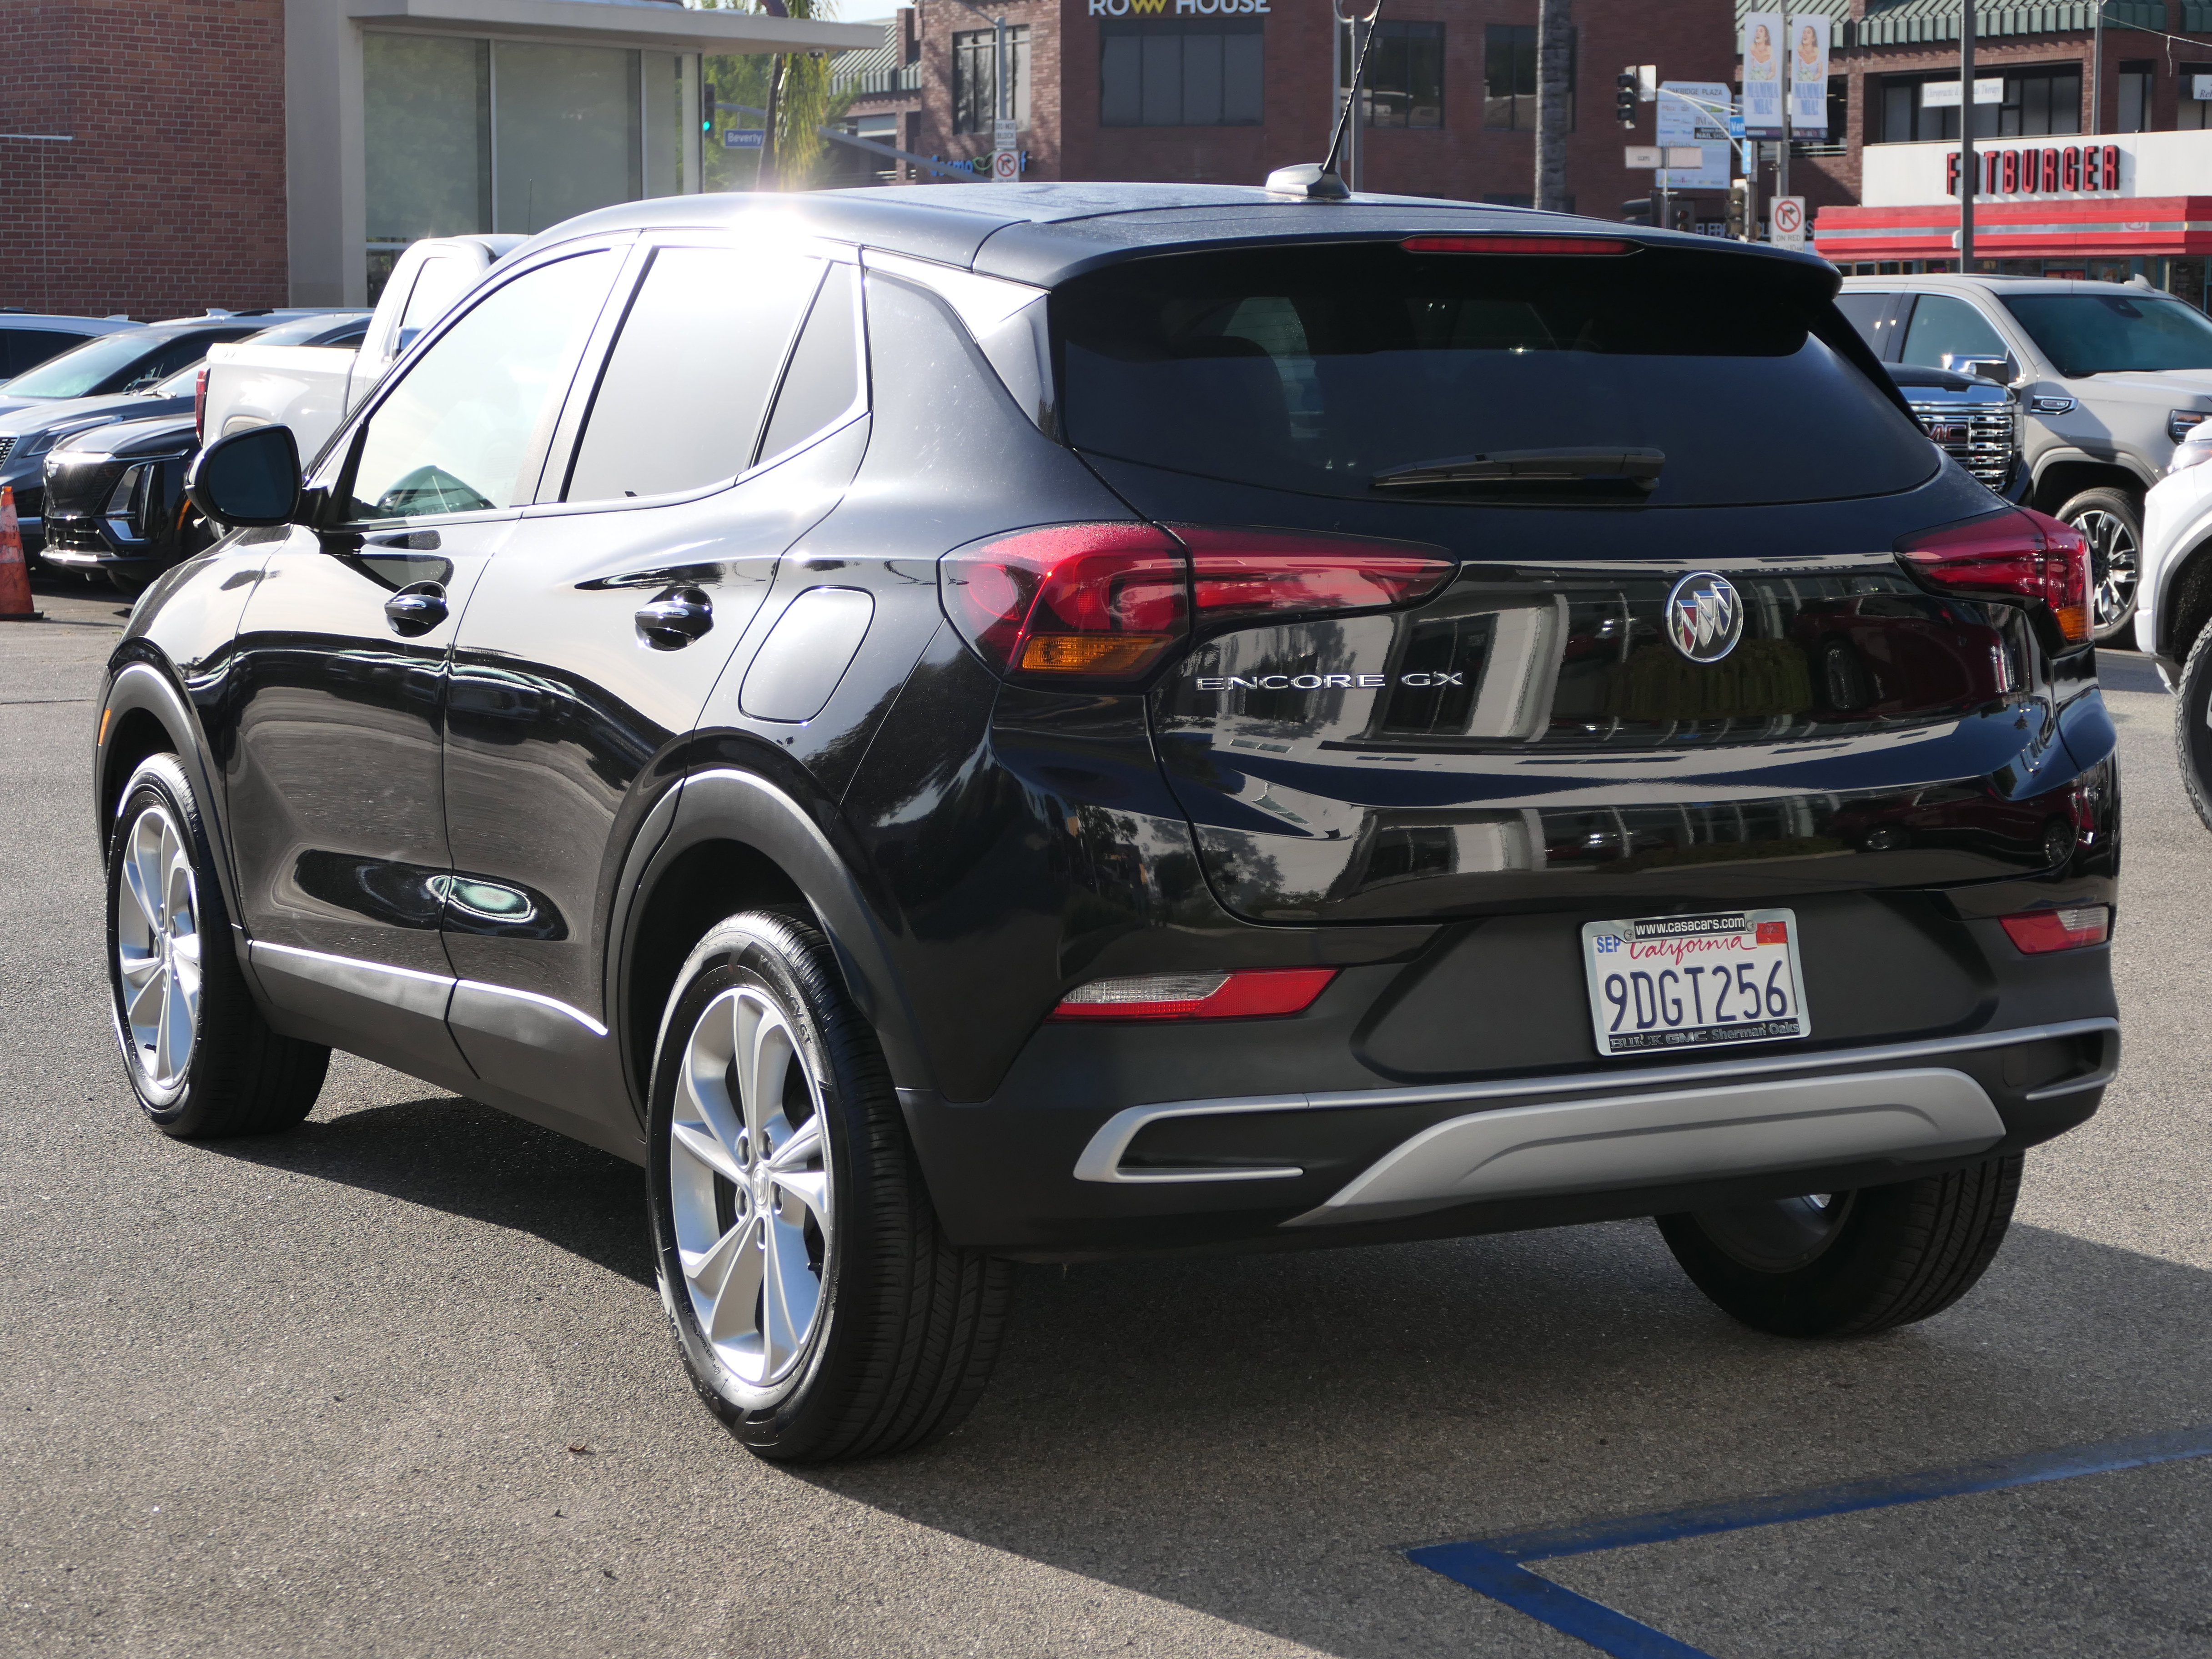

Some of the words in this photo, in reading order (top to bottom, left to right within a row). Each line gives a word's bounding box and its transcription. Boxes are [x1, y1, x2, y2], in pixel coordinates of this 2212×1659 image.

[1176, 0, 1271, 14] HOUSE
[1946, 145, 2120, 195] FTBURGER
[1196, 674, 1386, 691] ENCORE
[1401, 671, 1463, 686] GX
[1635, 917, 1745, 935] www.casacars.com
[1597, 935, 1621, 954] SEP
[1630, 935, 1758, 966] California
[1605, 960, 1788, 1032] 9DGT256
[1610, 1034, 1664, 1049] BUICK
[1665, 1031, 1708, 1045] GMC
[1712, 1024, 1766, 1041] Sherman
[1769, 1021, 1800, 1035] Oaks
